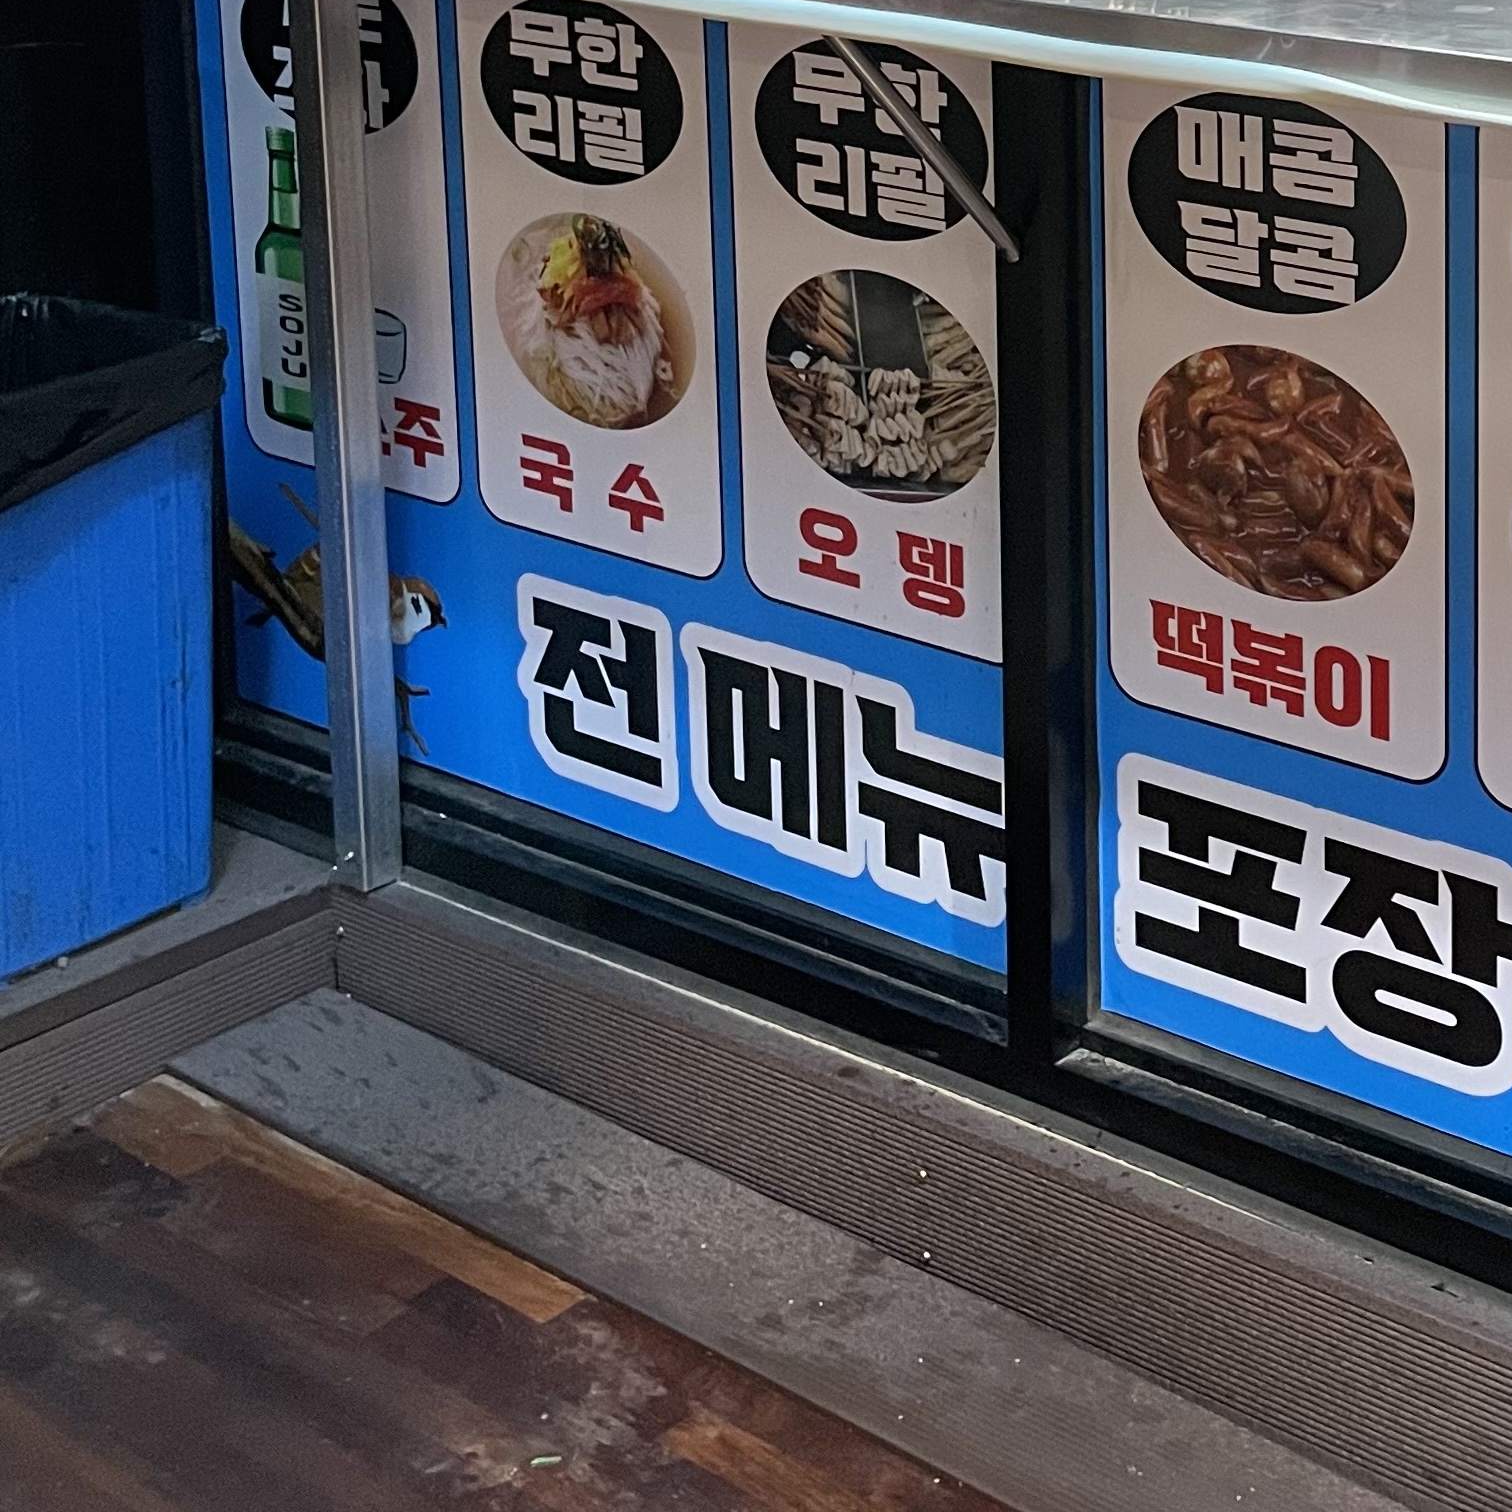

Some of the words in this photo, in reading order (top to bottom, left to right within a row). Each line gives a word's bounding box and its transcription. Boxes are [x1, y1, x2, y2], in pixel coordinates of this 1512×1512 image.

[508, 7, 641, 91] 무한
[513, 92, 647, 176] 리필
[1175, 106, 1359, 208] 매콤
[796, 138, 947, 232] 리필
[1178, 200, 1359, 305] 달콤
[279, 293, 307, 378] SOJU
[1150, 599, 1390, 741] 떡볶이
